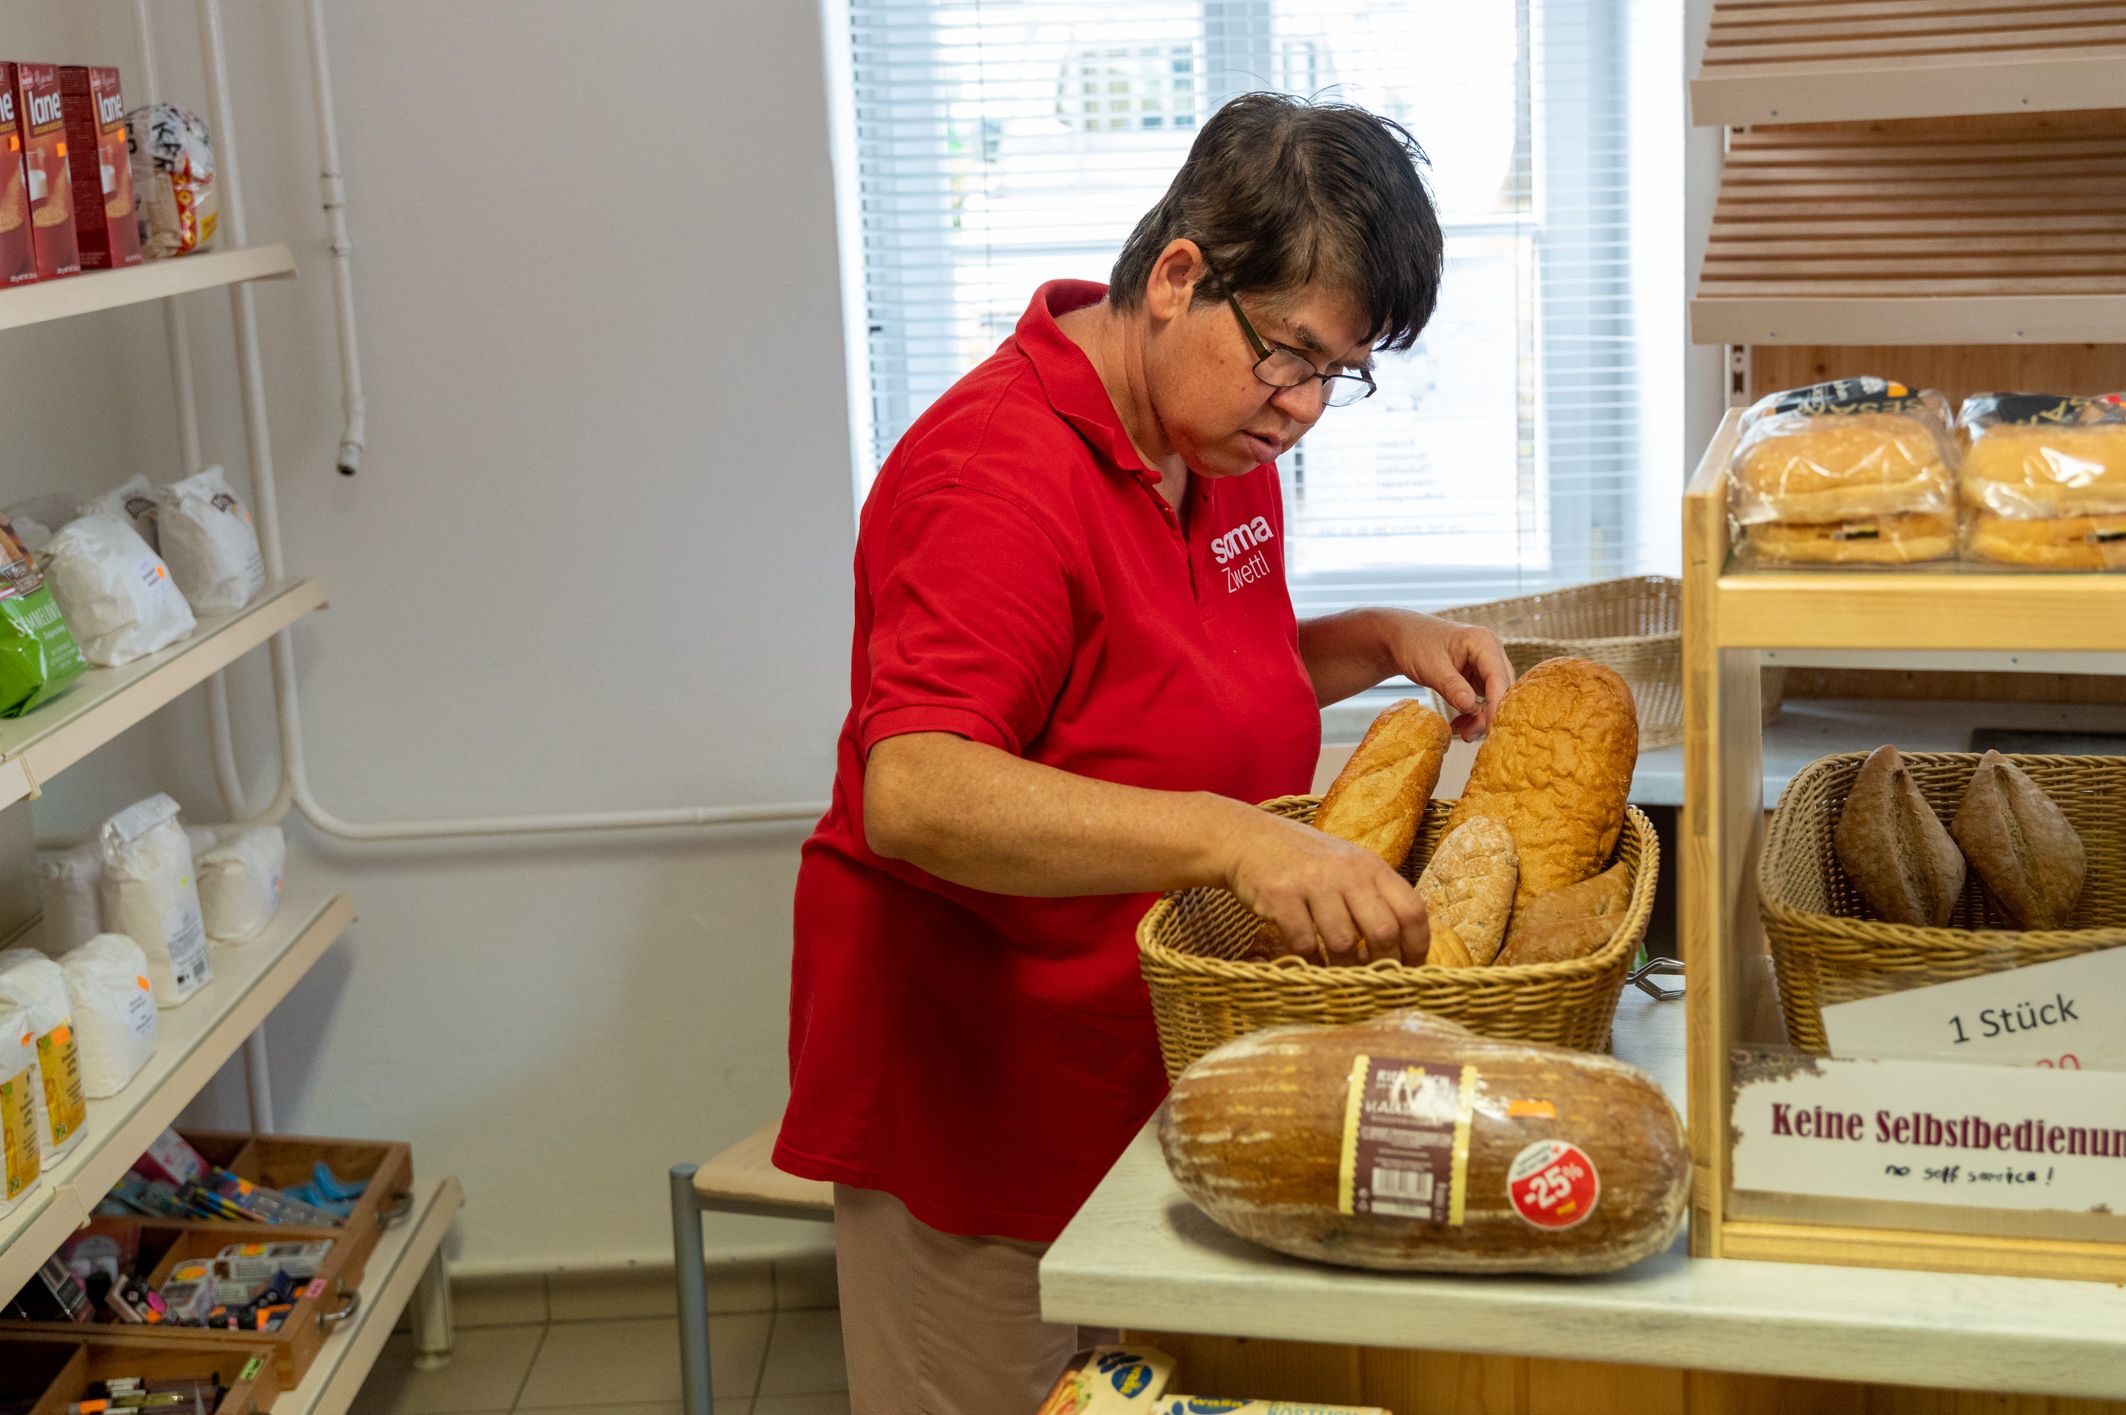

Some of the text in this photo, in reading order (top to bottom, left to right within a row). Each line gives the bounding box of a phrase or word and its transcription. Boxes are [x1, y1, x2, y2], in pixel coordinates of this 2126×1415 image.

[29, 91, 61, 125] lane
[98, 92, 124, 124] lane
[1211, 515, 1274, 564] soma
[1221, 549, 1270, 594] Zwettl
[1949, 993, 2078, 1044] 1 Stück
[1771, 1102, 2126, 1158] Keine Selbstbedienun
[1884, 1164, 1911, 1176] no
